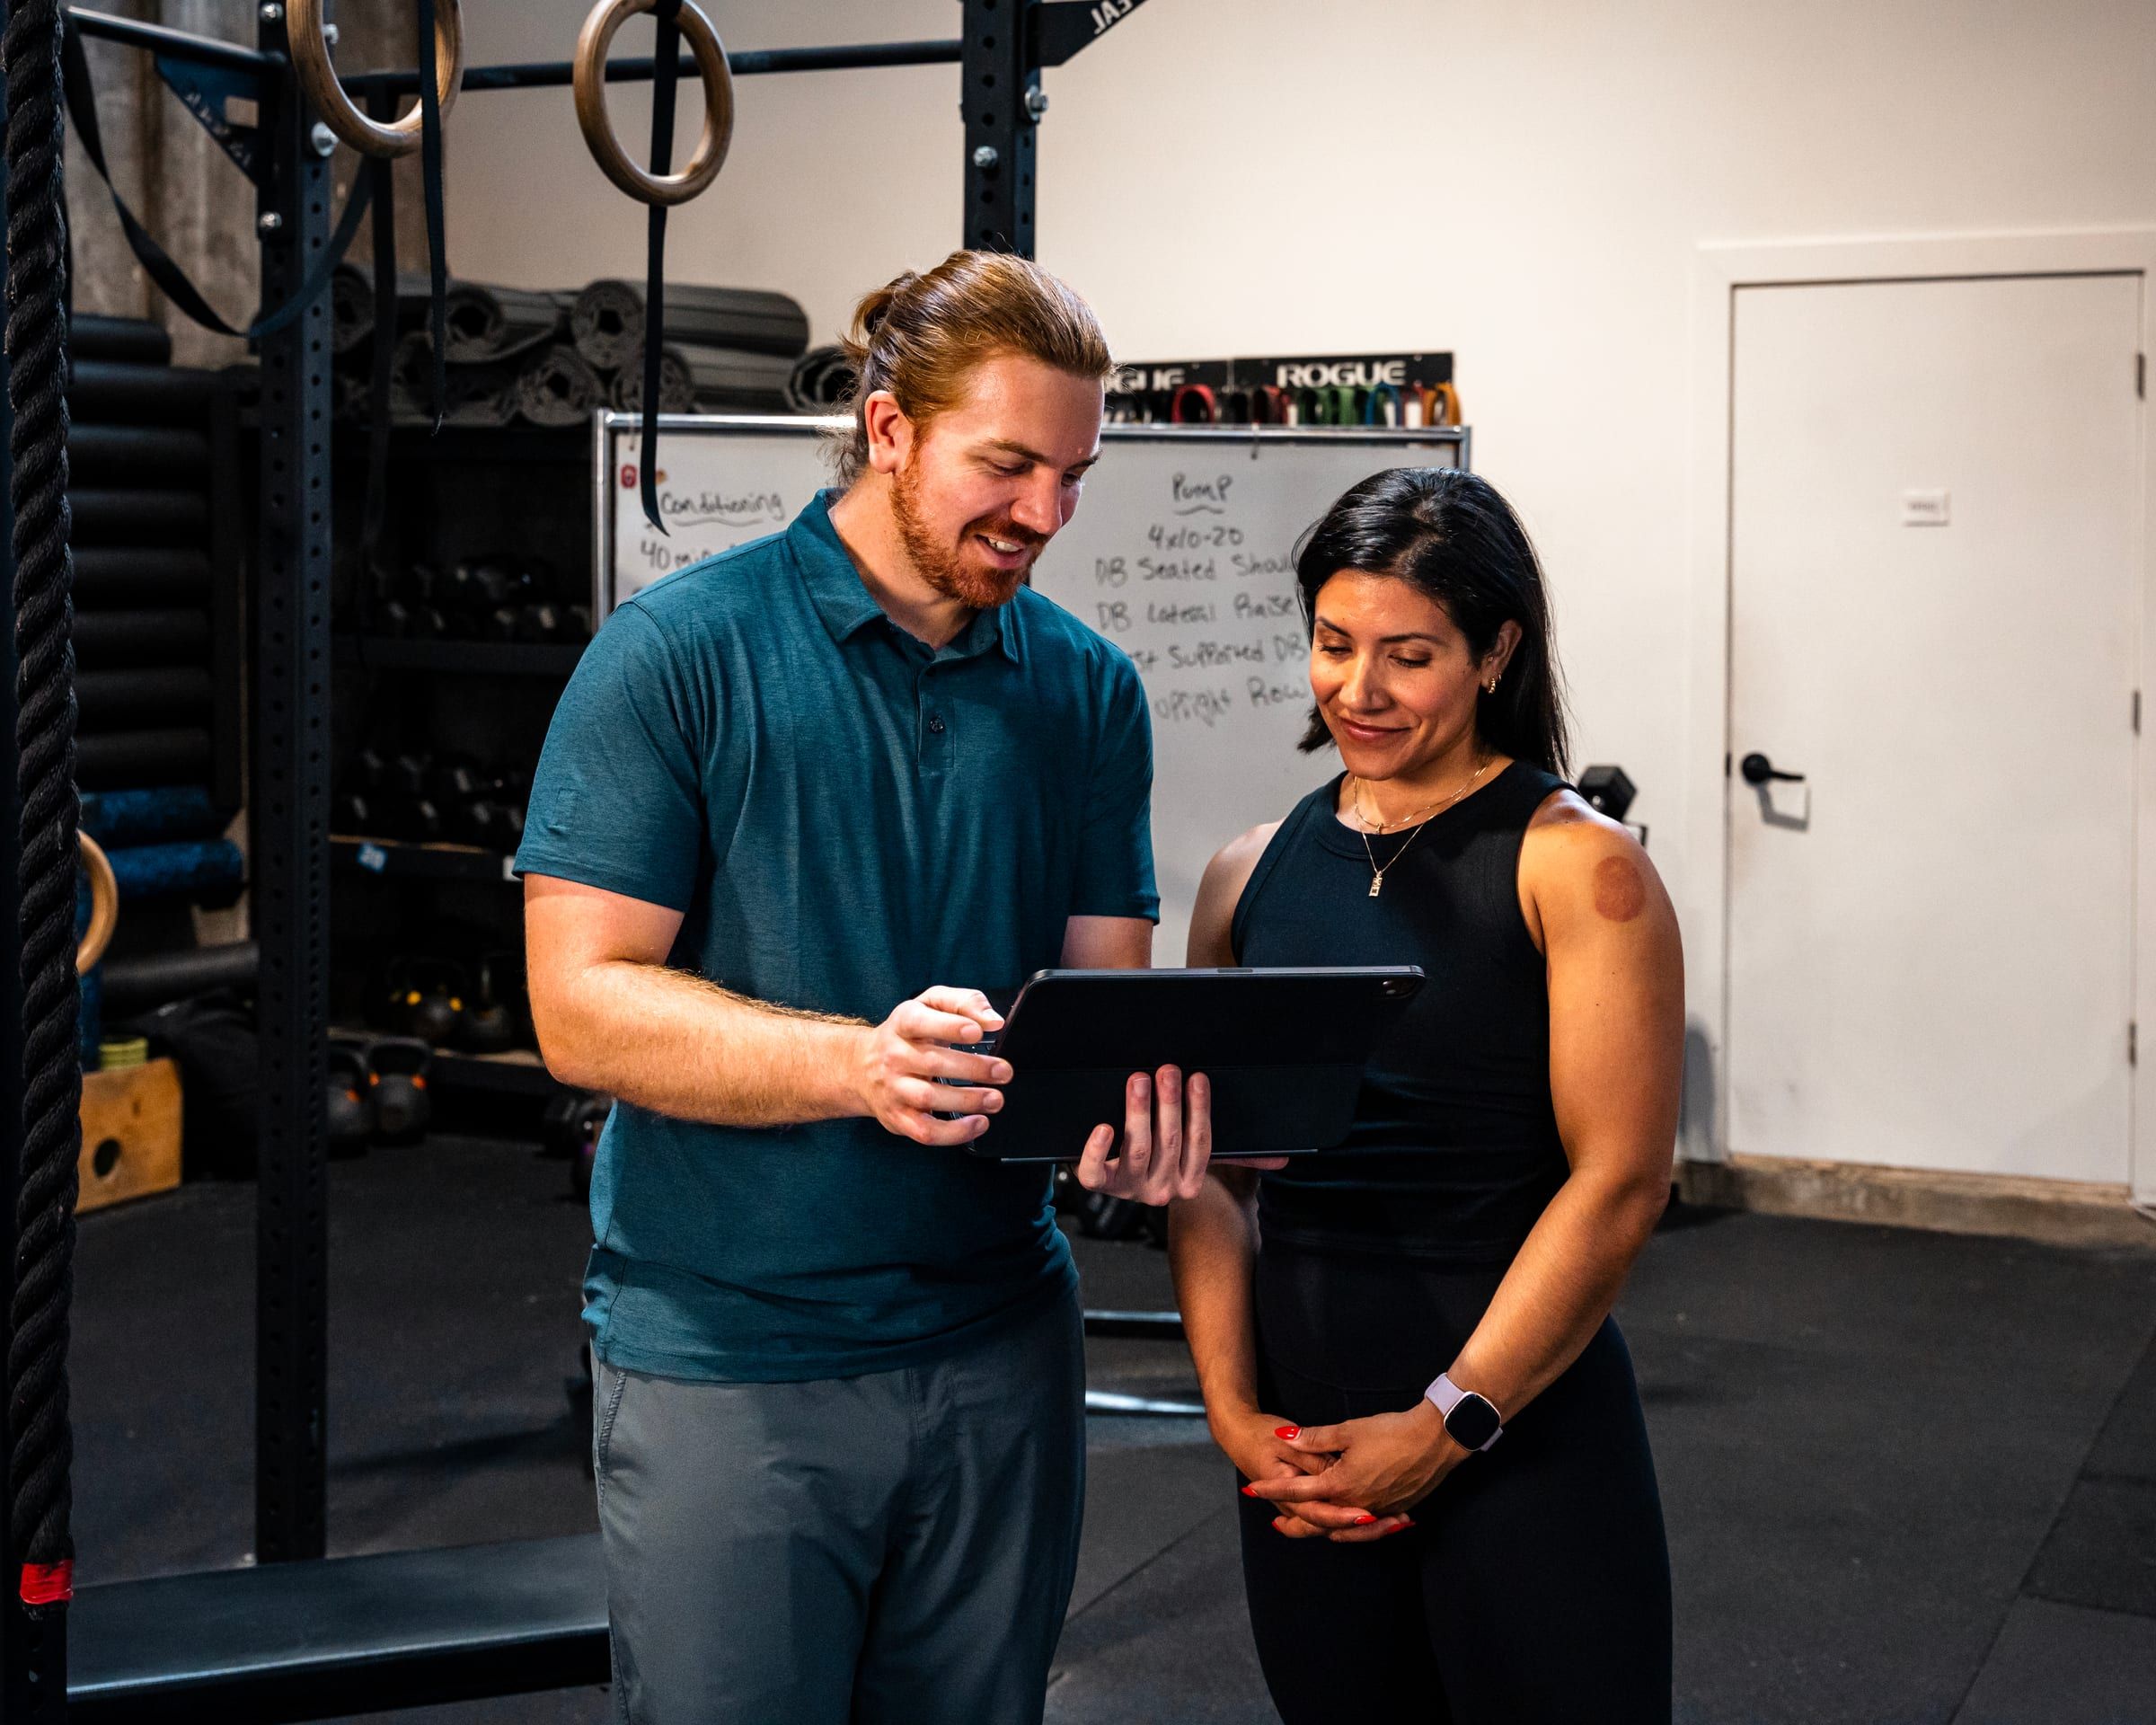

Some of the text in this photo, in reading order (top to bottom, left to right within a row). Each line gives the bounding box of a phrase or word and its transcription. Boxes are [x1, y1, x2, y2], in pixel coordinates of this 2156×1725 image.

[1277, 360, 1405, 388] ROGUE
[640, 539, 671, 571] 40
[1095, 556, 1129, 588] DB
[1136, 556, 1216, 582] Seated
[1097, 600, 1132, 632] DB
